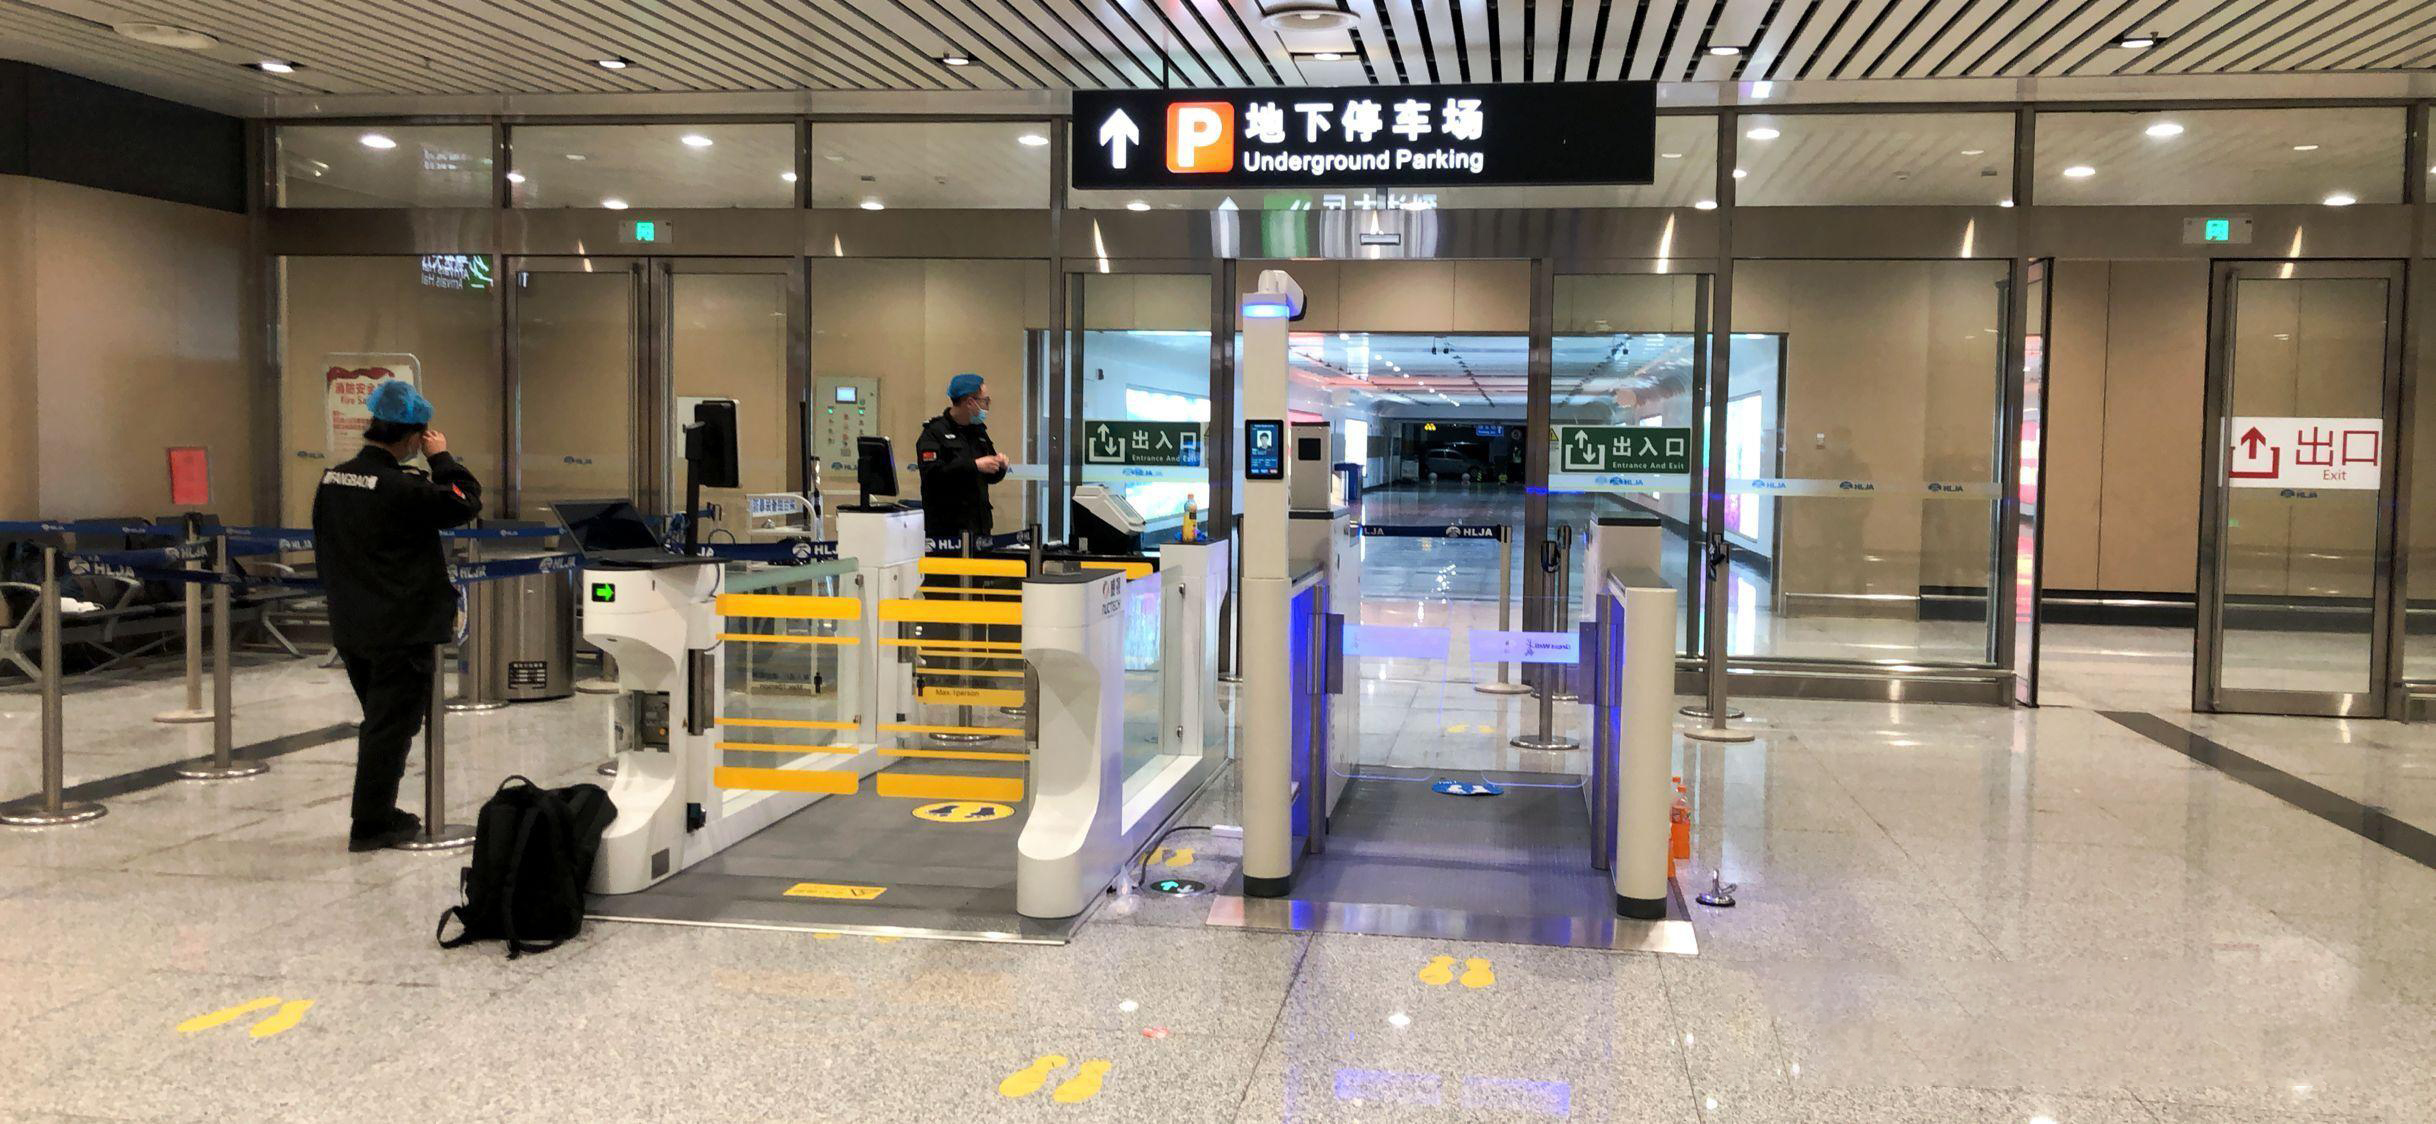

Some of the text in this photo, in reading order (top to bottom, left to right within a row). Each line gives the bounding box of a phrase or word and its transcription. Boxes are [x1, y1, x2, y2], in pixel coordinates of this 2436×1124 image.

[1245, 99, 1484, 144] 地下停车场
[1177, 107, 1223, 168] P
[1244, 148, 1484, 176] Underground Parking
[1131, 430, 1197, 450] 出入口
[1612, 436, 1685, 457] 出入口
[2295, 426, 2379, 467] 出口
[1132, 454, 1163, 462] Entrance
[1612, 461, 1685, 470] Entrance And Exit
[2323, 469, 2347, 480] Exit
[1463, 527, 1493, 537] HLJA
[94, 561, 135, 578] HLJA
[553, 557, 576, 569] HLJA
[460, 565, 486, 579] HLJA
